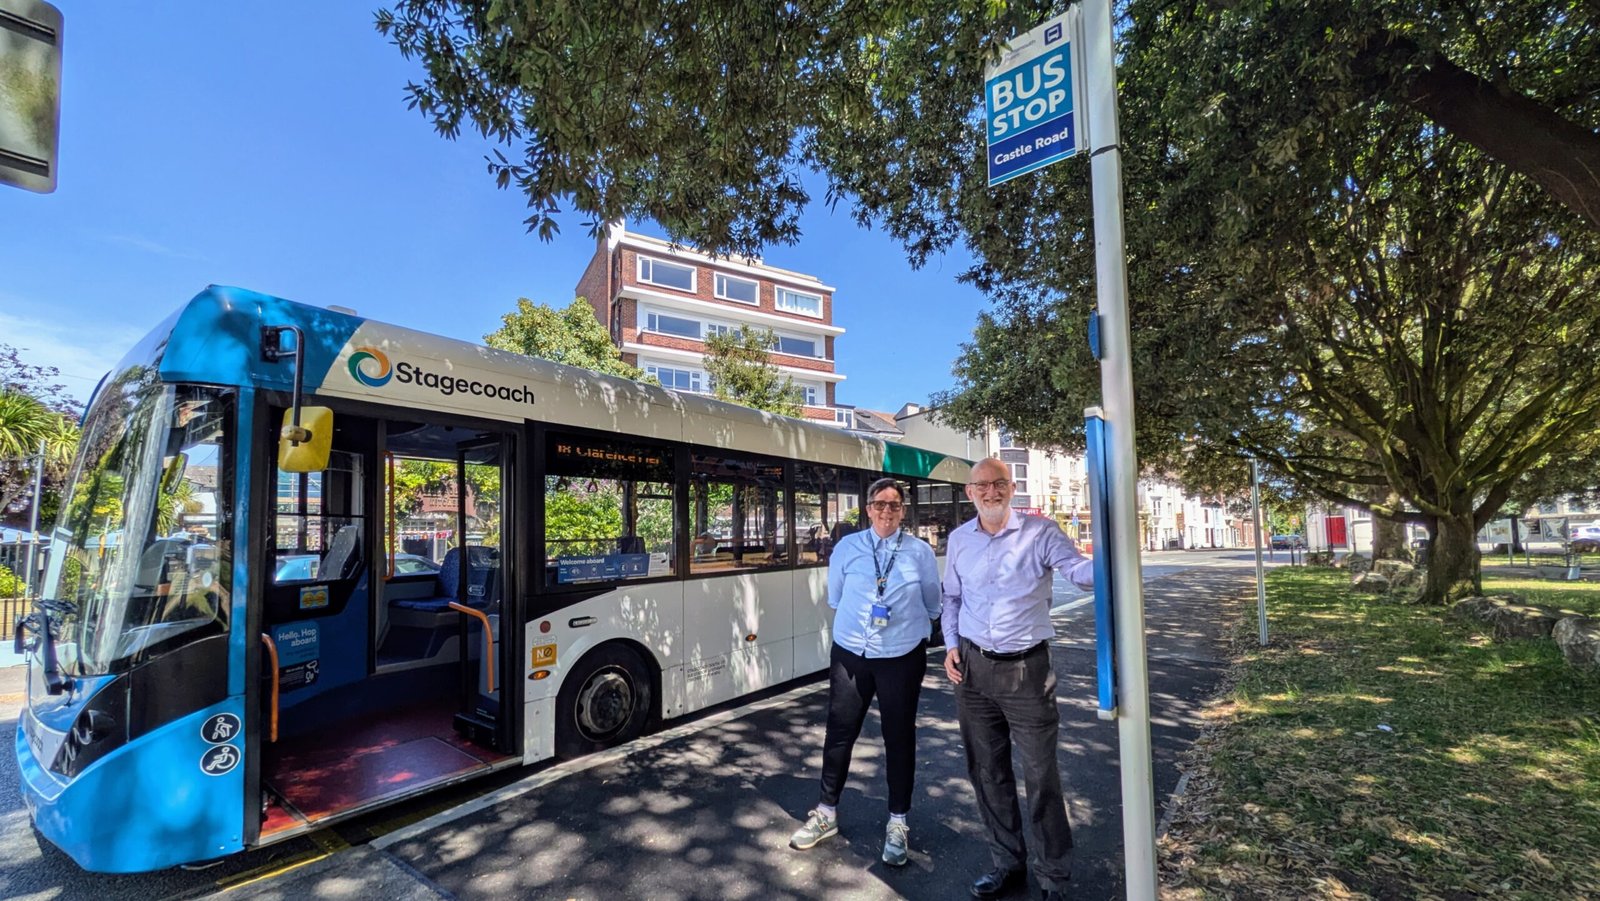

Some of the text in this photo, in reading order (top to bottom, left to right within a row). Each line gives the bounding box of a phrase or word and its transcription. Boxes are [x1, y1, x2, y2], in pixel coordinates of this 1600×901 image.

[992, 54, 1065, 113] BUS
[993, 89, 1066, 137] STOP
[994, 127, 1069, 166] Castle Road
[395, 361, 535, 405] Stagecoach
[586, 557, 605, 565] aboard
[291, 635, 317, 647] aboard
[301, 628, 316, 638] Hop
